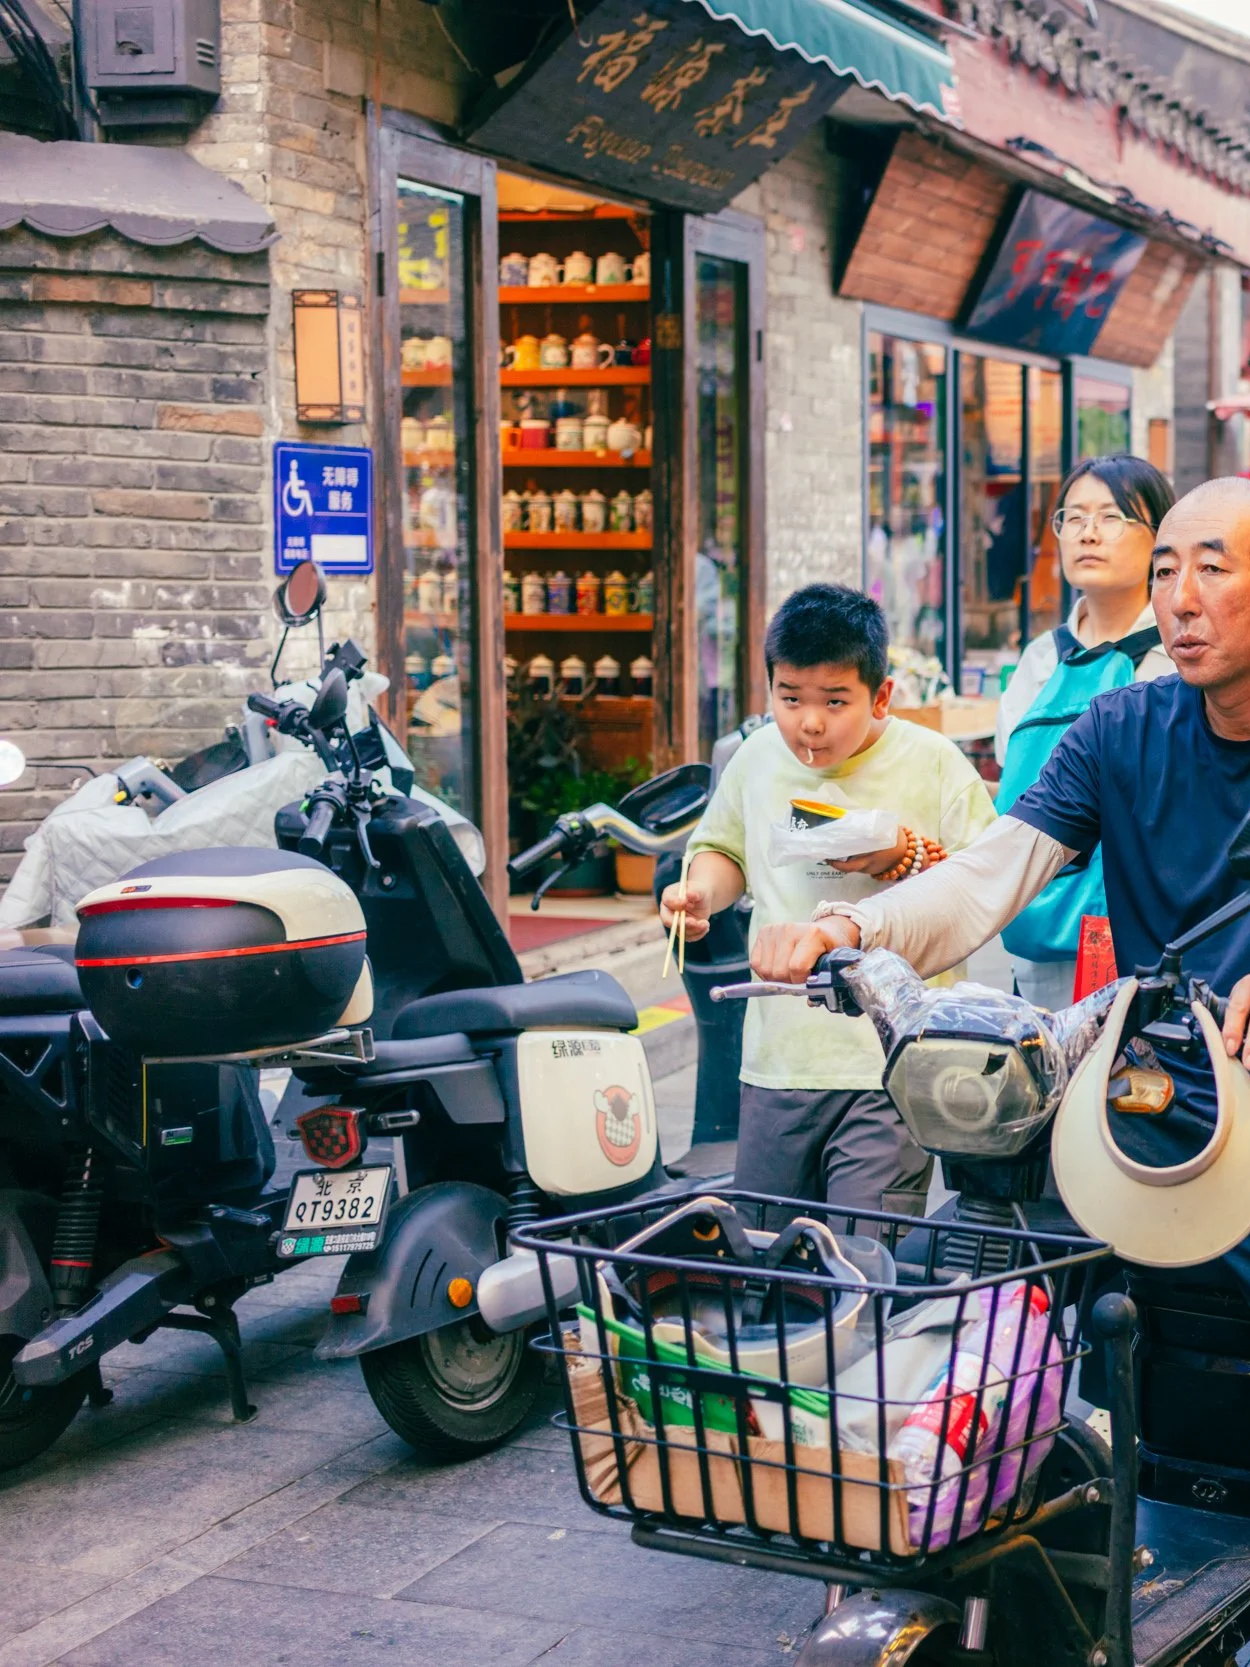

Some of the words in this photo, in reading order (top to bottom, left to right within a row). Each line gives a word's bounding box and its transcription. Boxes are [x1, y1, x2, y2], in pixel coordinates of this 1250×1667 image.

[322, 466, 359, 488] 无障碍
[328, 490, 353, 511] 服务
[315, 1172, 366, 1196] 北京
[295, 1196, 374, 1222] QT9382
[69, 1334, 94, 1361] TCS
